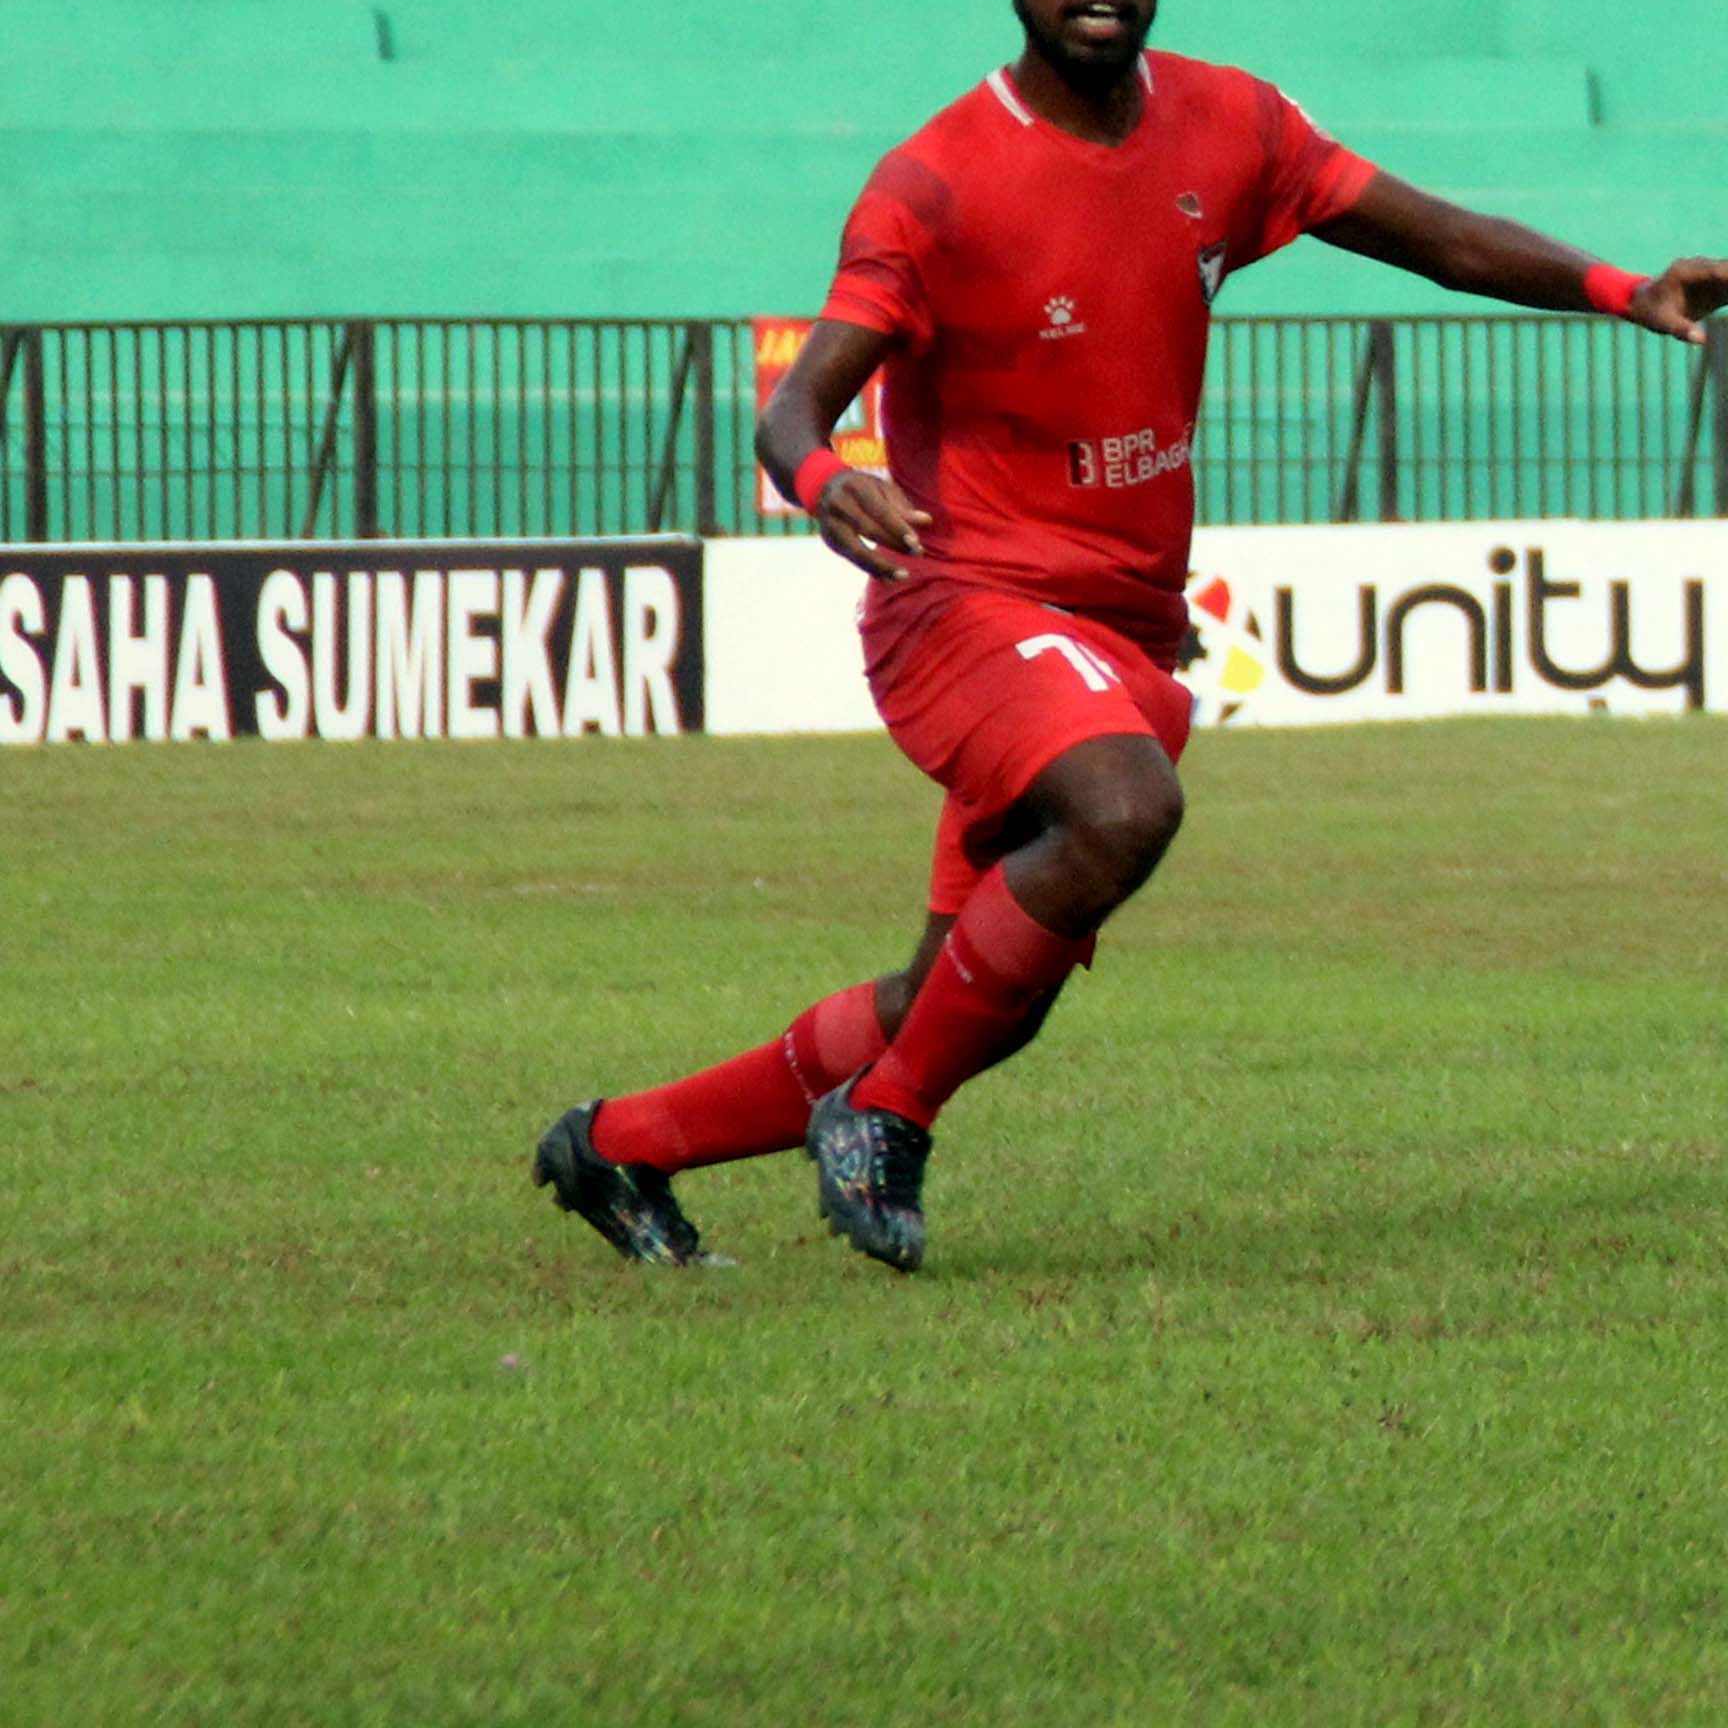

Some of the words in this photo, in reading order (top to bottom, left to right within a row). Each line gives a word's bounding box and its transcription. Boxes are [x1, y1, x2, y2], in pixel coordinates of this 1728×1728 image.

[1102, 428, 1155, 463] BPR
[255, 565, 684, 739] SUMEKAR
[1273, 545, 1705, 713] unity
